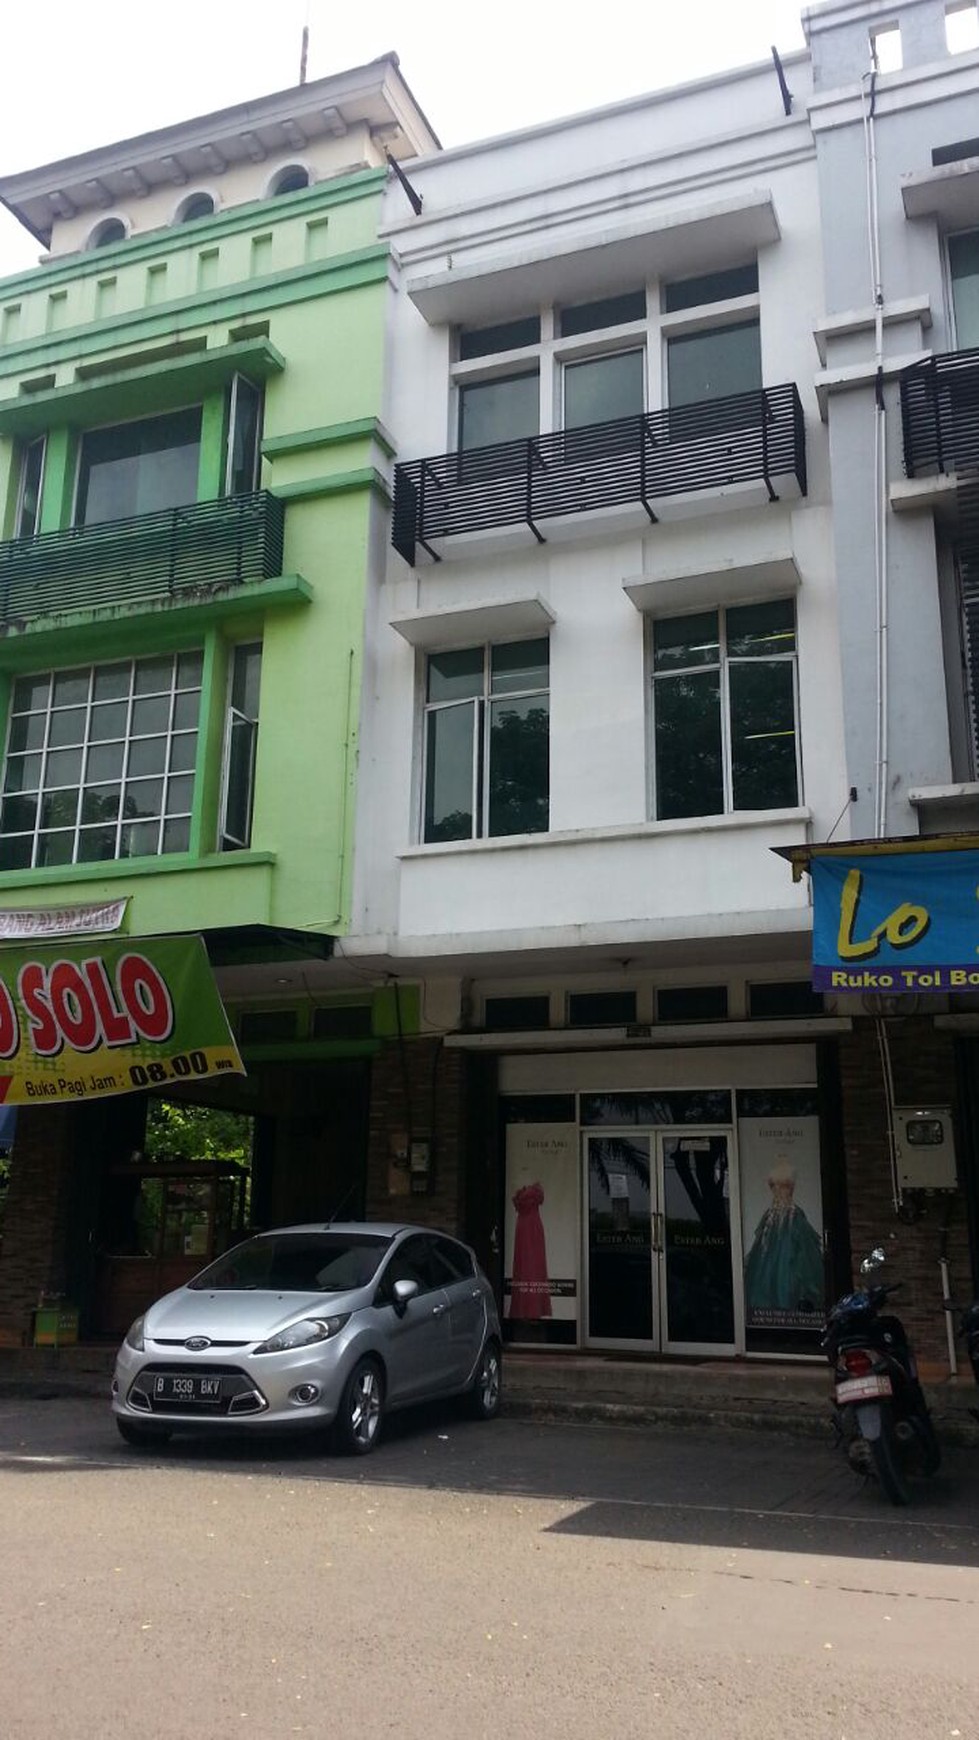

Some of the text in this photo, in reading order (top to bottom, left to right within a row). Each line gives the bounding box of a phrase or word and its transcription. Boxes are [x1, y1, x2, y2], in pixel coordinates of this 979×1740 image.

[837, 868, 929, 958] Lo
[831, 970, 893, 987] Ruko
[901, 970, 941, 987] Tol
[18, 953, 174, 1056] SOLO
[25, 1080, 57, 1097] Buka
[59, 1077, 87, 1096] Pagi
[89, 1074, 117, 1091] Jam
[129, 1051, 209, 1087] 08.00
[157, 1377, 220, 1395] B 1339 BKV
